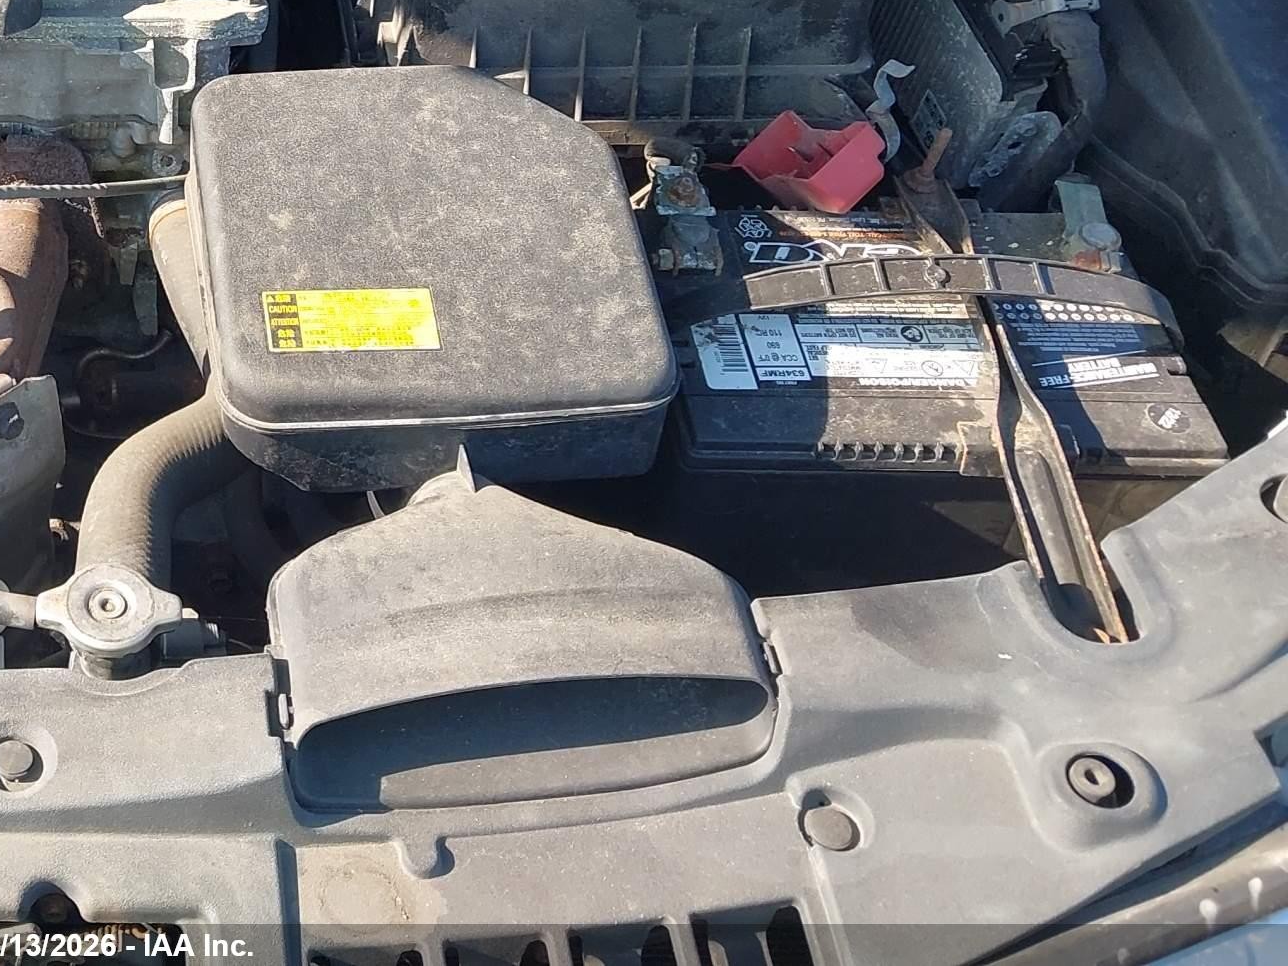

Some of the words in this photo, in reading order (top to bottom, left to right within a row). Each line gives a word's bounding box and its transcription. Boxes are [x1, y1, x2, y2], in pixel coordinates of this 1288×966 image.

[782, 354, 799, 362] CCA
[1067, 357, 1121, 371] BATTERY
[761, 368, 806, 377] 634RMF
